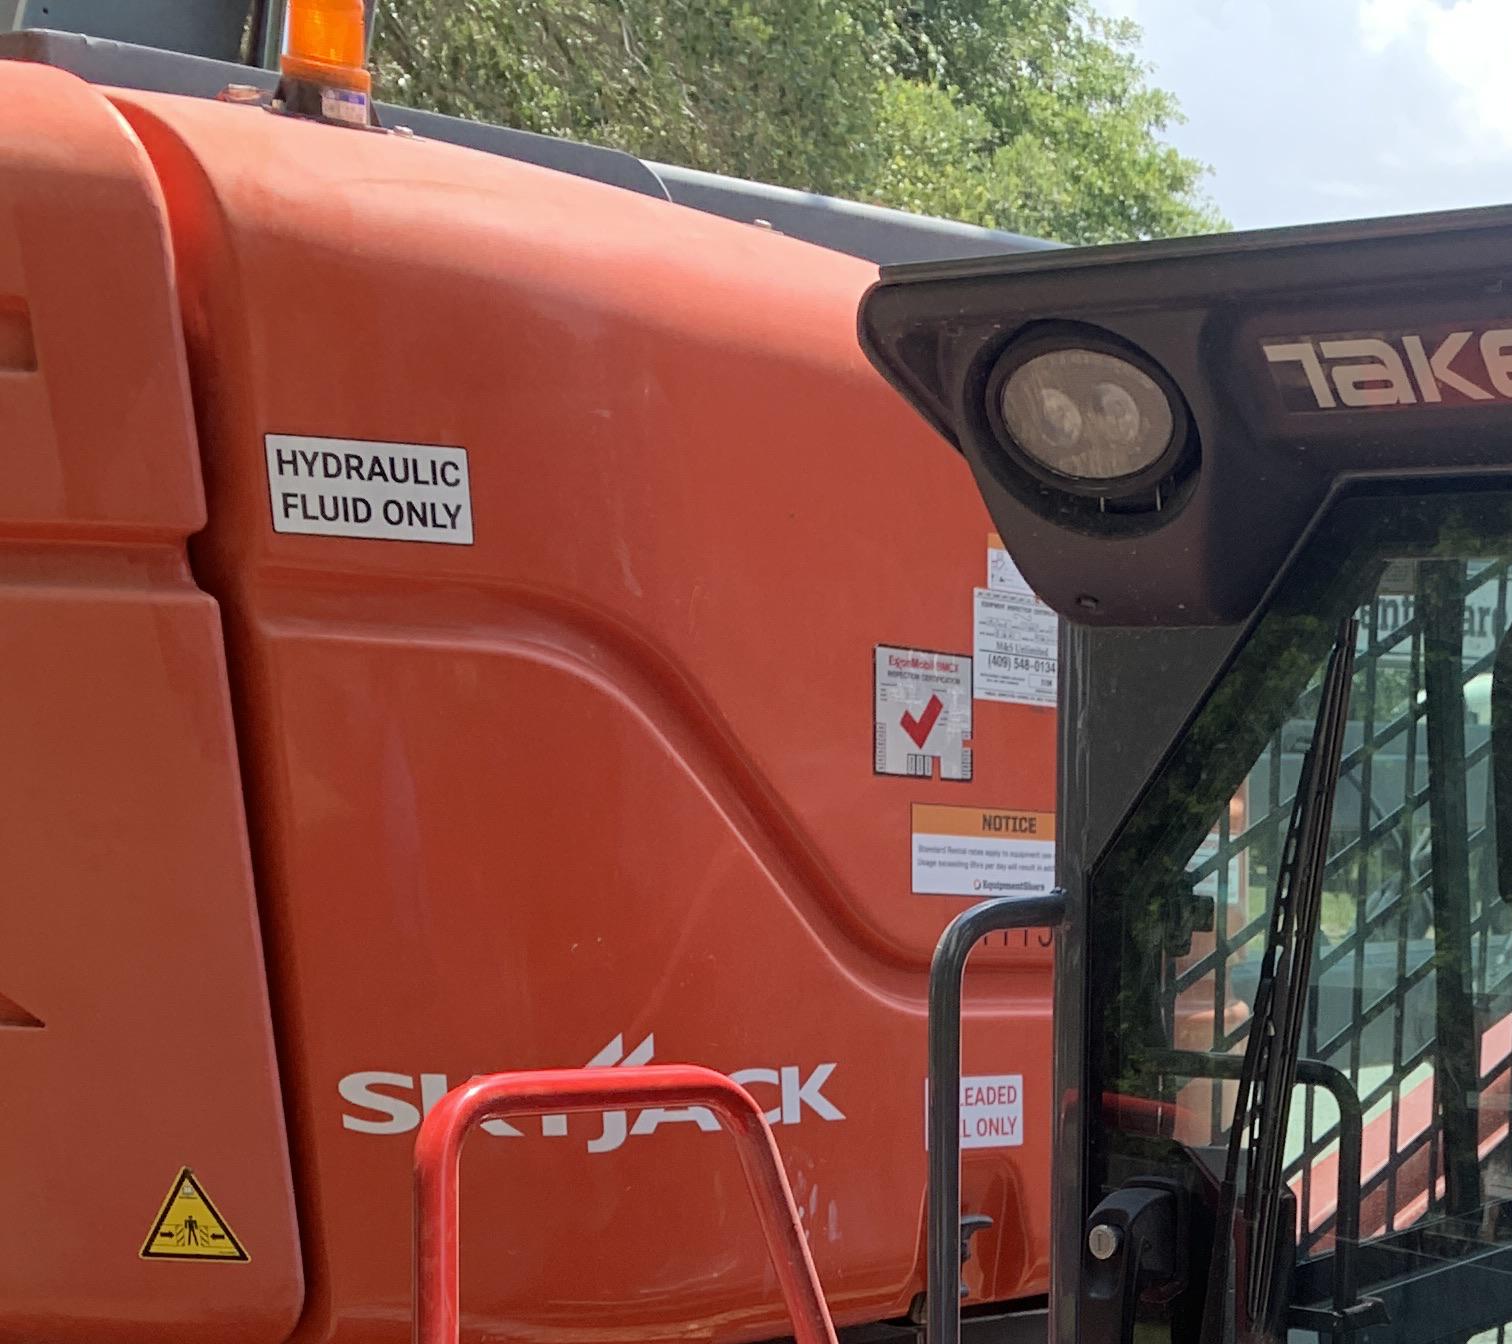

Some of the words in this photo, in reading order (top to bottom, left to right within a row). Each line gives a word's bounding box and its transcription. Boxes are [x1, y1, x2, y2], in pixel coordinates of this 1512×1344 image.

[275, 449, 461, 488] HYDRAULIC
[283, 492, 373, 527] FLUID
[382, 498, 463, 531] ONLY
[1014, 657, 1056, 674] 548-0134
[982, 813, 1037, 834] NOTICE
[976, 1115, 1018, 1137] ONLY
